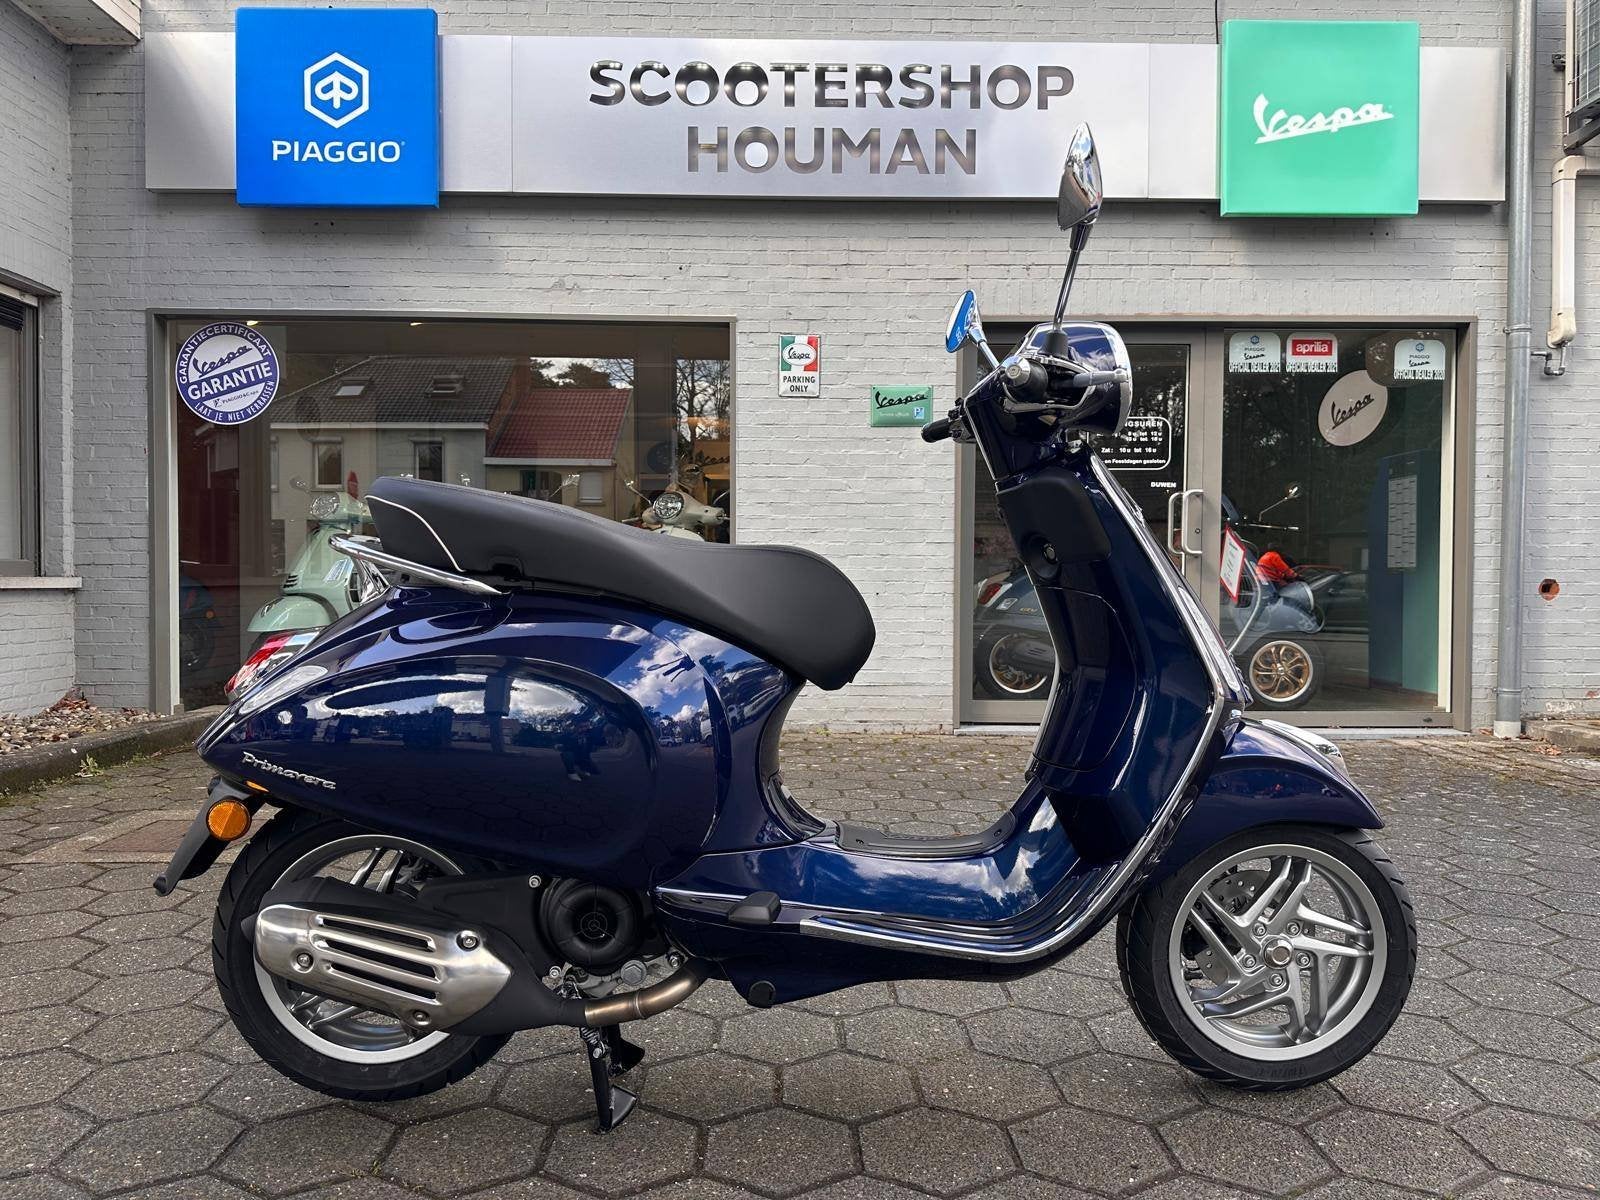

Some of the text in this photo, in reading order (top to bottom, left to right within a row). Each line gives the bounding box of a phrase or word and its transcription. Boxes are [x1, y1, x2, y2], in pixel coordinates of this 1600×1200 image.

[589, 60, 1074, 110] SCOOTERSHOP
[1253, 93, 1394, 144] Vespa
[272, 140, 401, 163] PIAGGIO
[687, 126, 976, 175] HOUMAN
[179, 325, 272, 384] GARANTIECERTIFICAAT
[192, 345, 253, 378] Vespa
[787, 346, 811, 360] Vespa
[1295, 341, 1329, 354] aprilia
[187, 361, 273, 400] GARANTIE
[789, 385, 809, 393] ONLY
[194, 402, 212, 417] LAAT
[227, 413, 245, 421] NIET
[874, 390, 929, 409] Vespa
[1331, 394, 1375, 430] Vespa
[241, 751, 337, 790] Primavera
